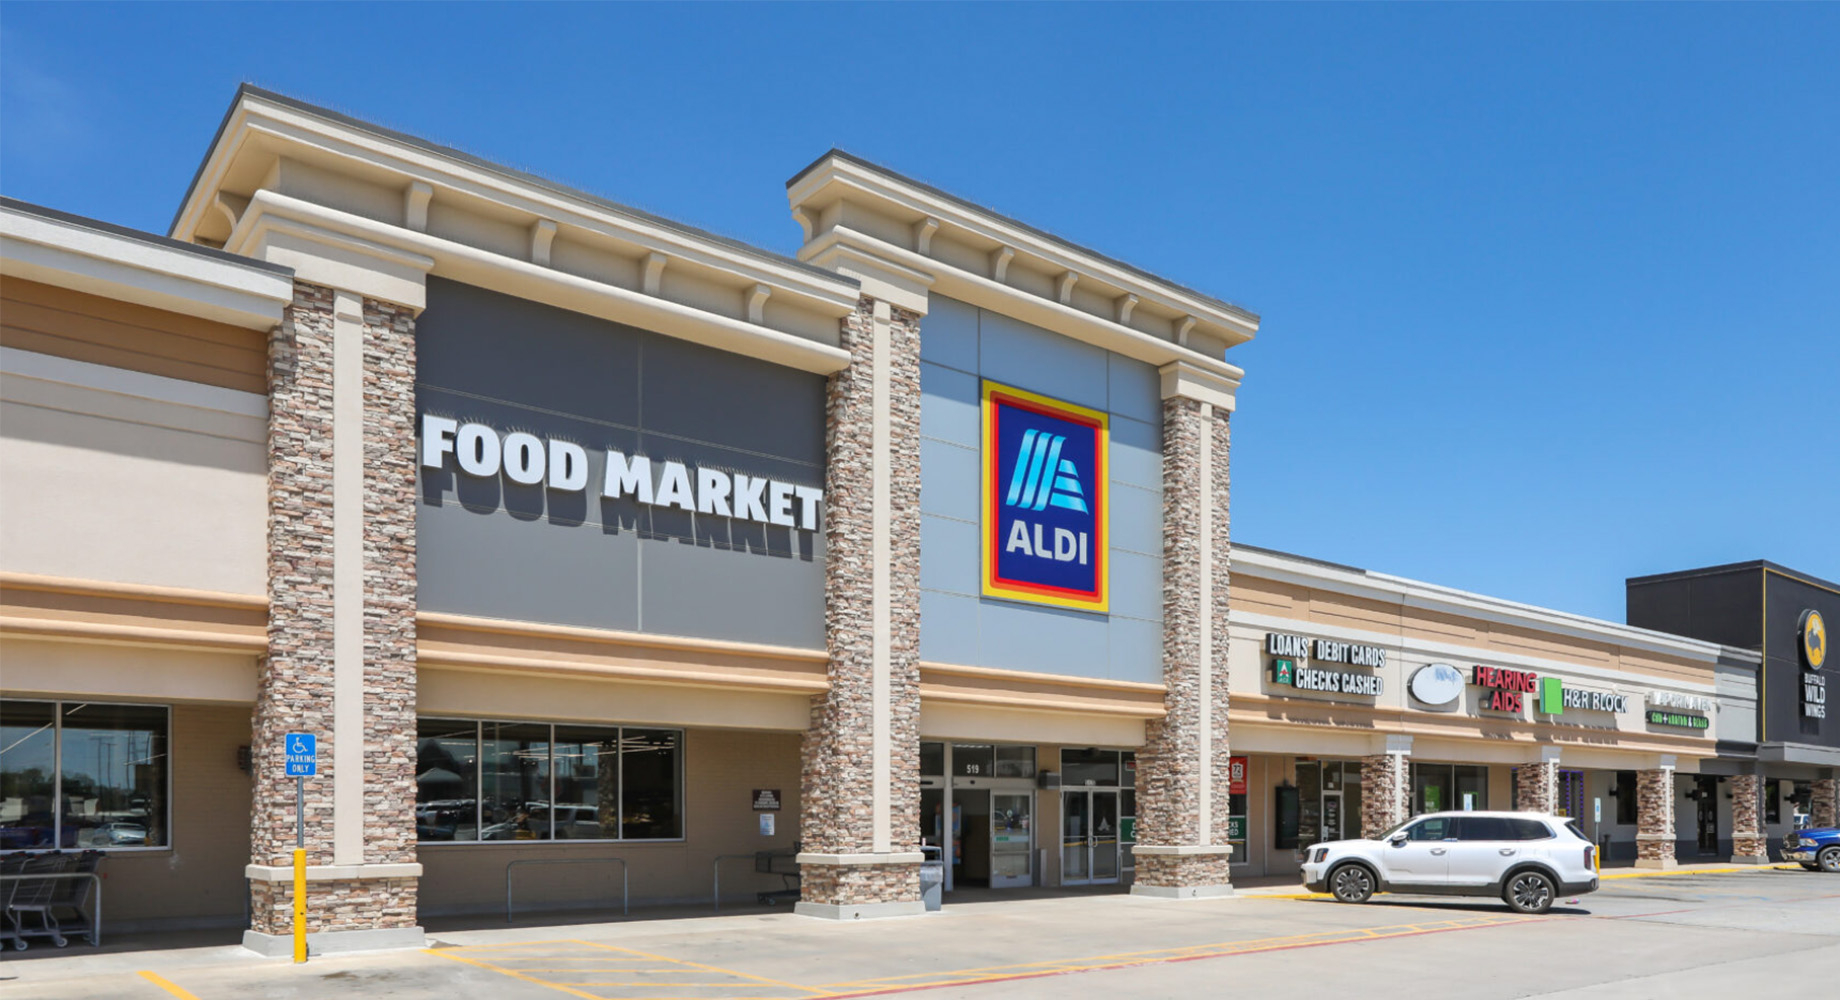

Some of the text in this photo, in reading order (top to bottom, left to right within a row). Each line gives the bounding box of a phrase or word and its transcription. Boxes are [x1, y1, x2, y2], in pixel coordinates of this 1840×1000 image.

[422, 414, 823, 531] FOOD MARKET
[1006, 519, 1087, 565] ALDI
[1270, 633, 1386, 668] LOANS DEBIT CARDS
[1295, 668, 1384, 696] CHECKS CASHED
[1476, 665, 1537, 693] HEARING
[1804, 672, 1825, 687] BUFFALO
[1491, 690, 1523, 713] AIDS
[1563, 689, 1629, 714] H&R BLOCK
[1804, 683, 1826, 704] WILD
[1804, 702, 1826, 719] WINGS
[286, 754, 316, 763] PARKING
[292, 764, 309, 773] ONLY
[966, 764, 980, 774] 519
